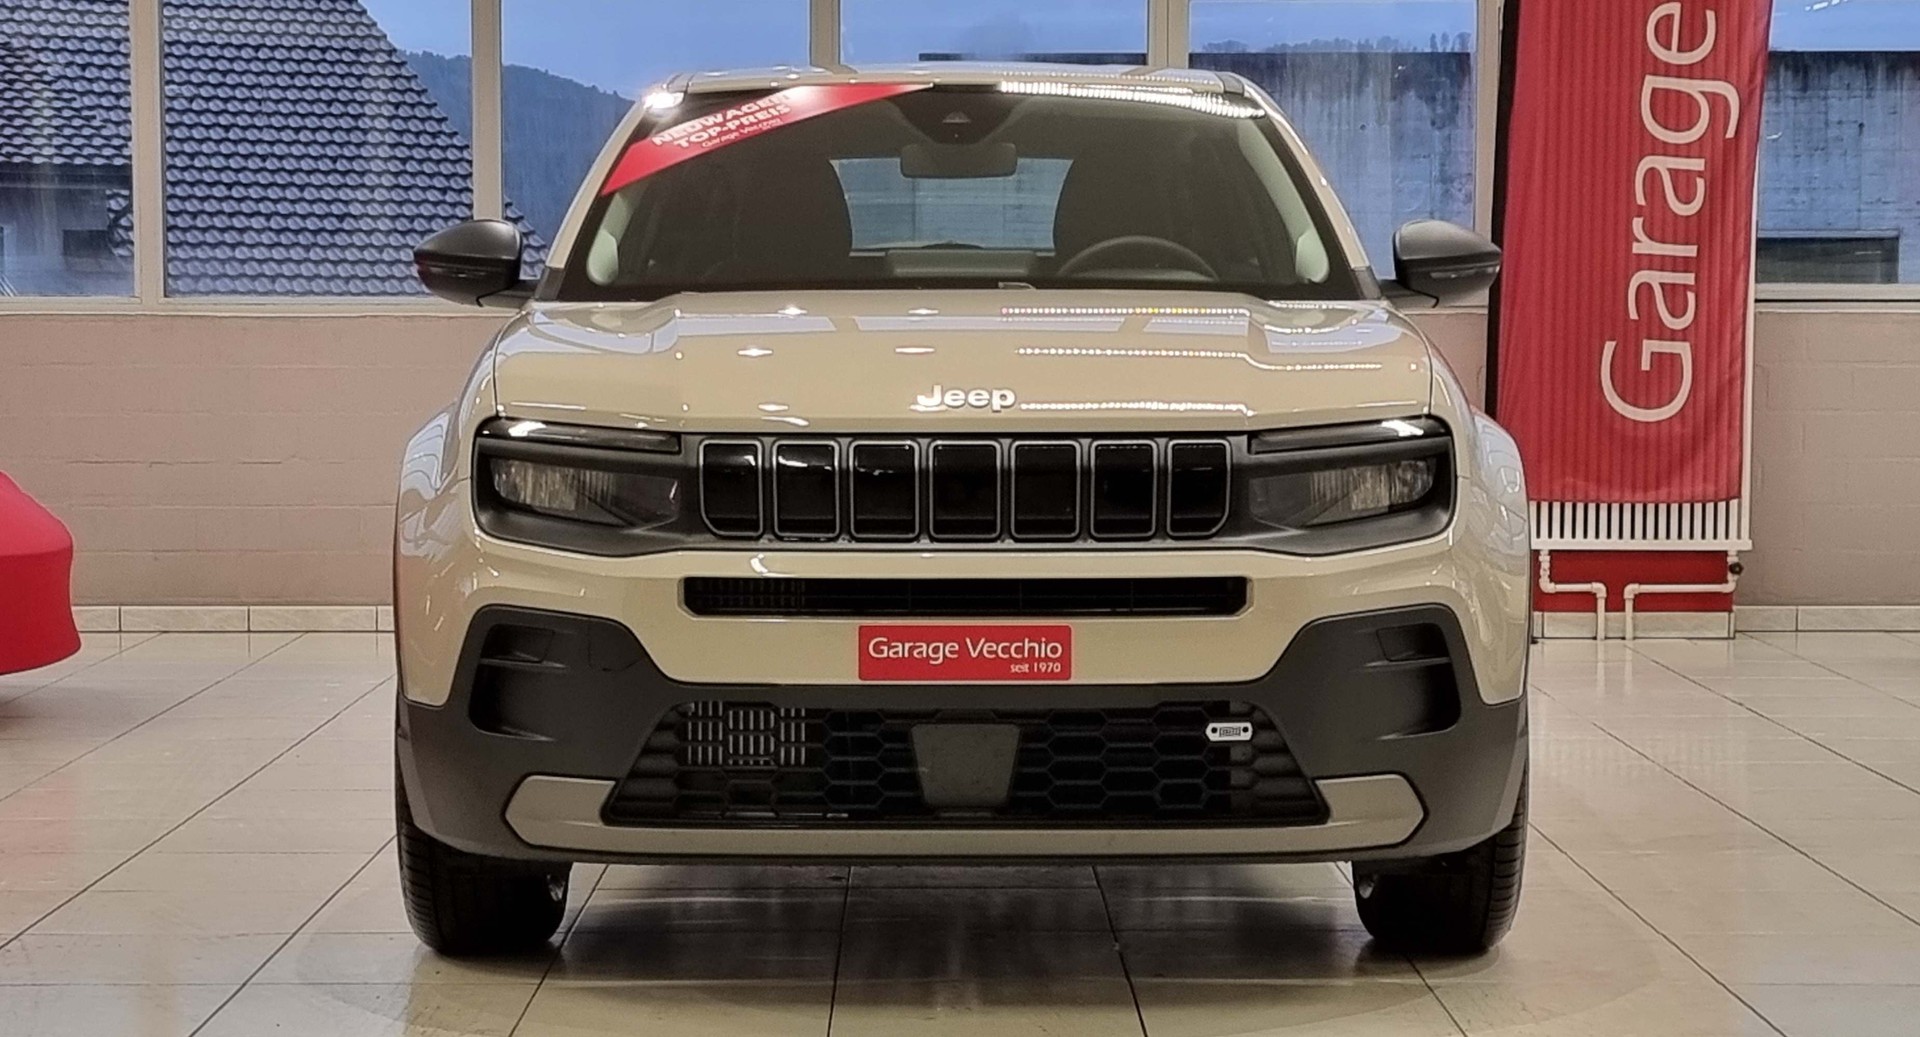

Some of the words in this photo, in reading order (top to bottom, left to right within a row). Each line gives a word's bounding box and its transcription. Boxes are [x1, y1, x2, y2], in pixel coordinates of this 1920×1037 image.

[673, 103, 791, 148] TOP-PREIS
[1600, 1, 1740, 422] Garage
[916, 384, 1015, 412] Jeep
[868, 637, 959, 665] Garage
[965, 637, 1063, 659] Vecchio
[1010, 663, 1029, 673] seit
[1033, 663, 1061, 673] 1970
